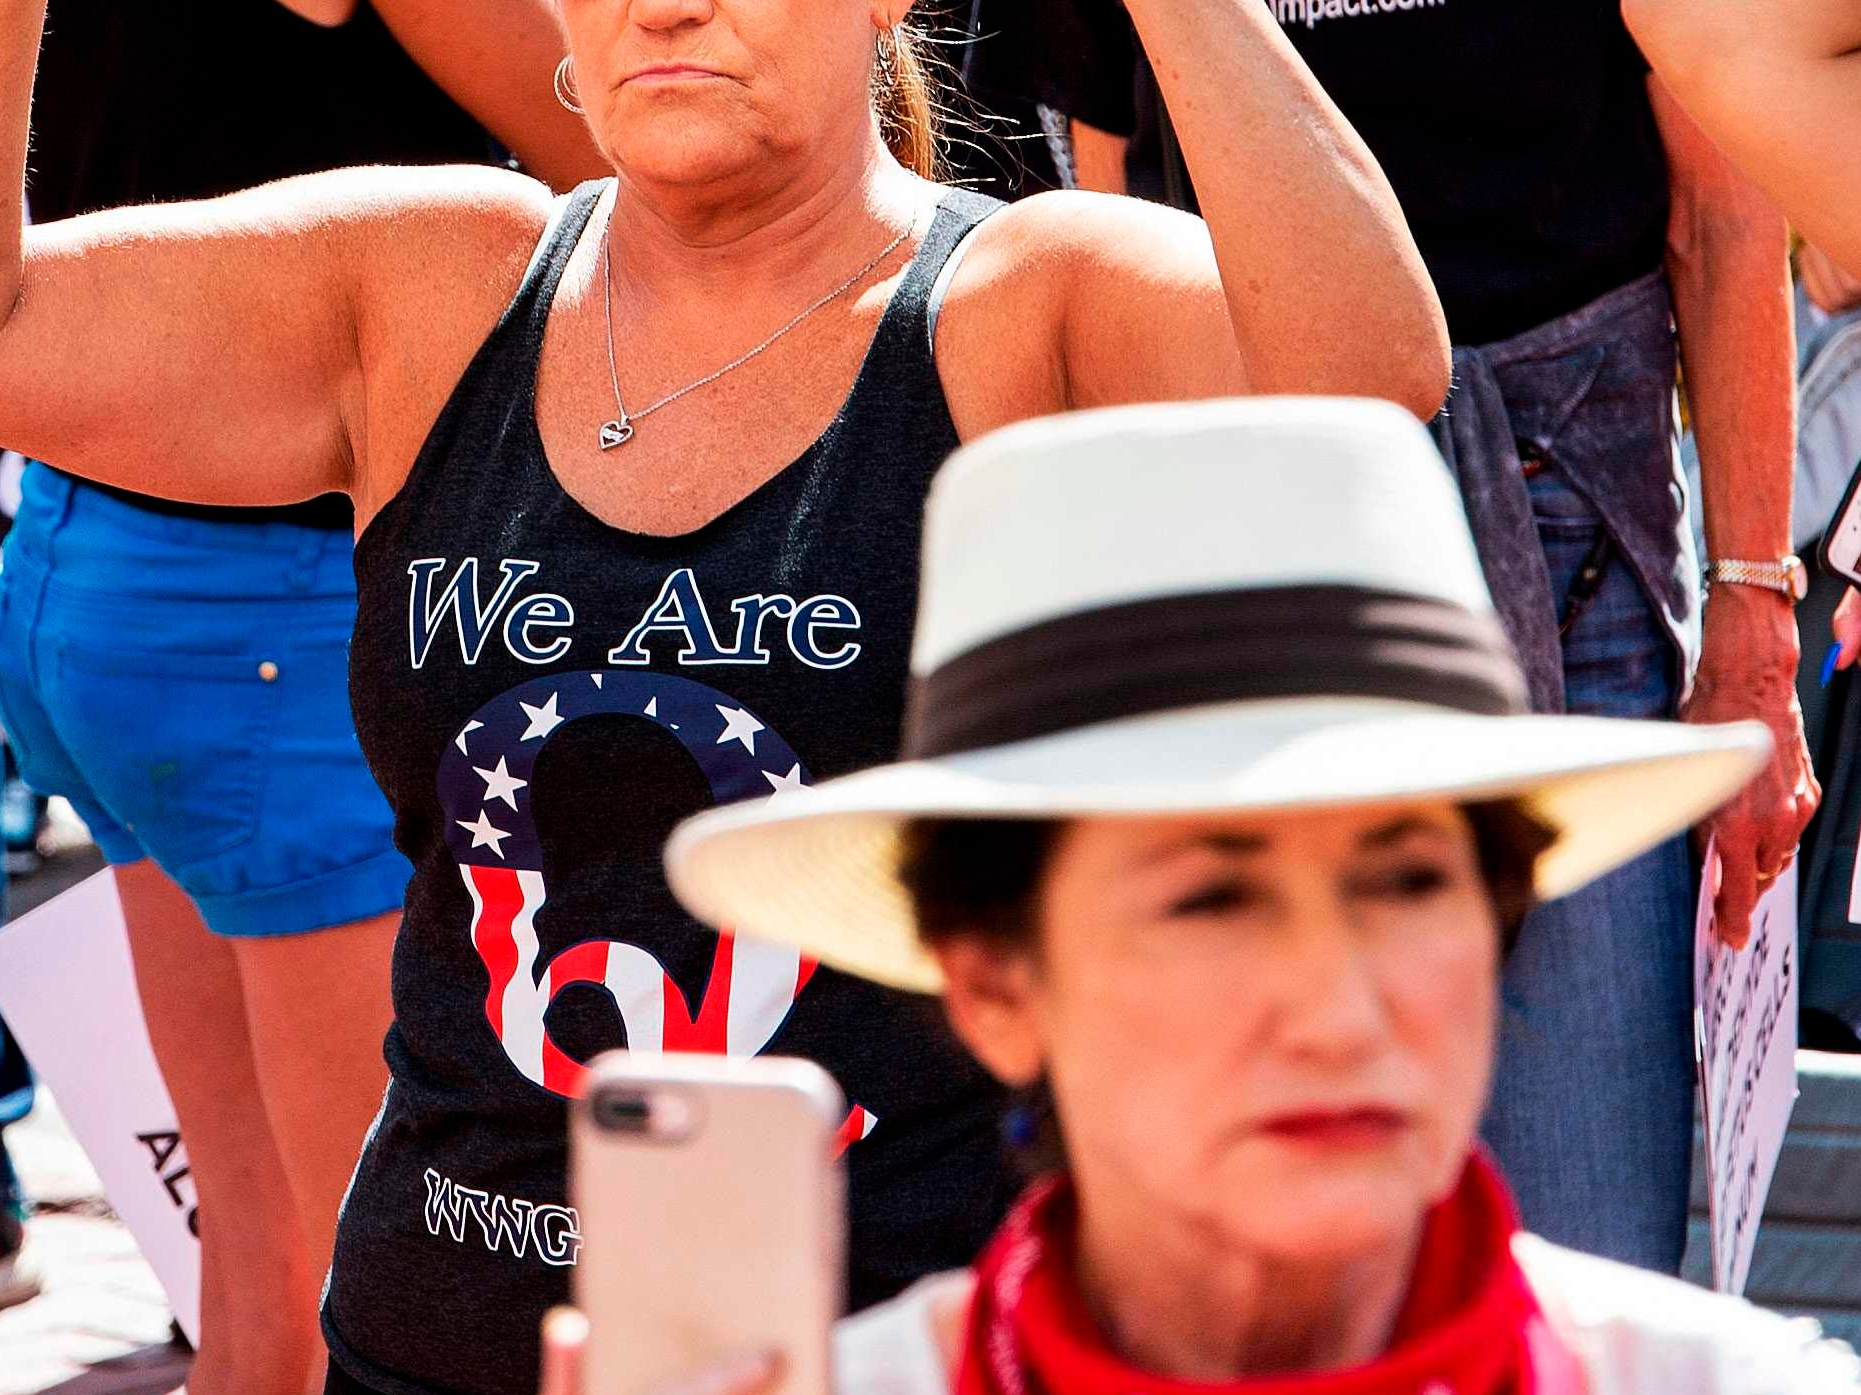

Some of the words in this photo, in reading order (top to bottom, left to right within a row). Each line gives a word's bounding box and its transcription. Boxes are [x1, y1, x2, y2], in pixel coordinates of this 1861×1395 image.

[407, 557, 575, 669] We
[608, 567, 861, 670] Are
[424, 1168, 584, 1266] WWG
